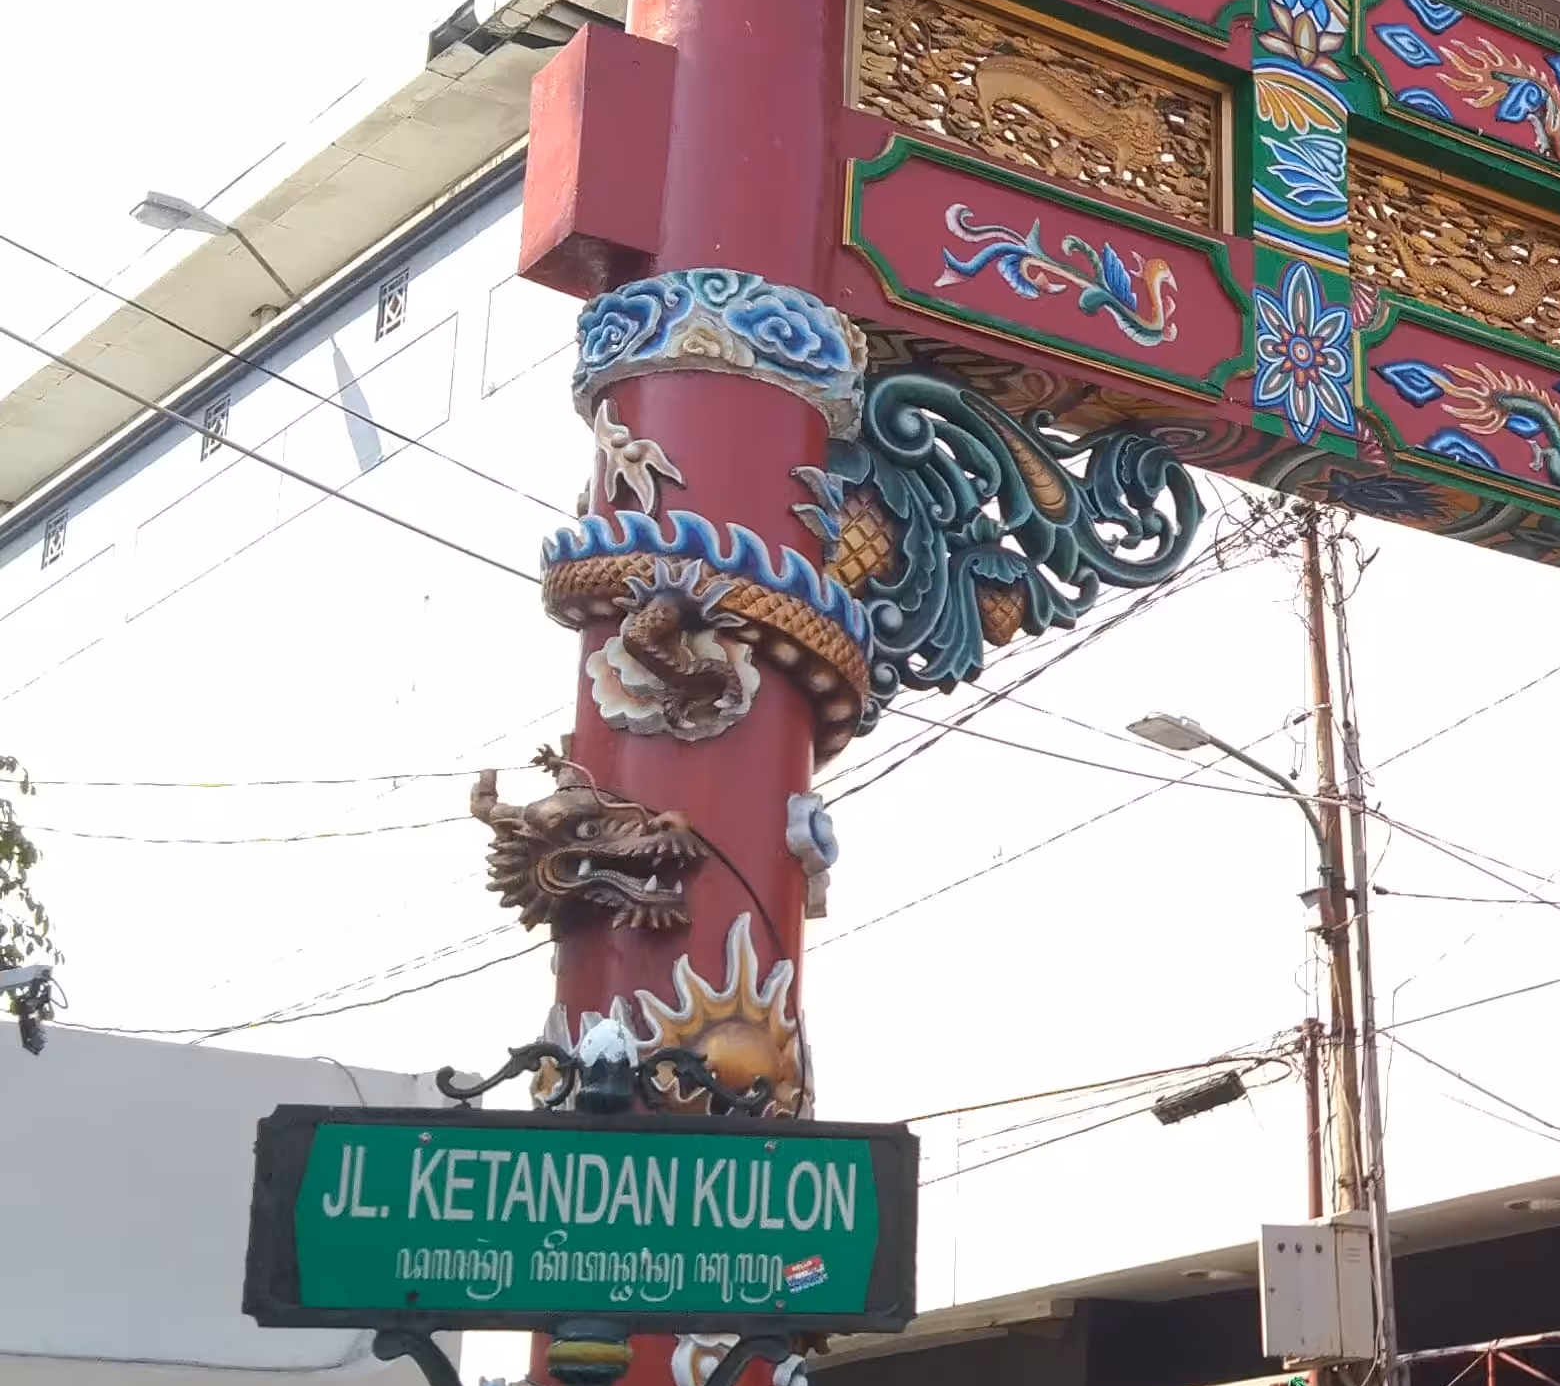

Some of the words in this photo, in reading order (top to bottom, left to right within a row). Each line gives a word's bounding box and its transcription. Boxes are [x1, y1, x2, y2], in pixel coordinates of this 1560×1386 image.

[322, 1144, 390, 1219] JL.
[407, 1148, 679, 1227] KETANDAN
[691, 1157, 857, 1232] KULON
